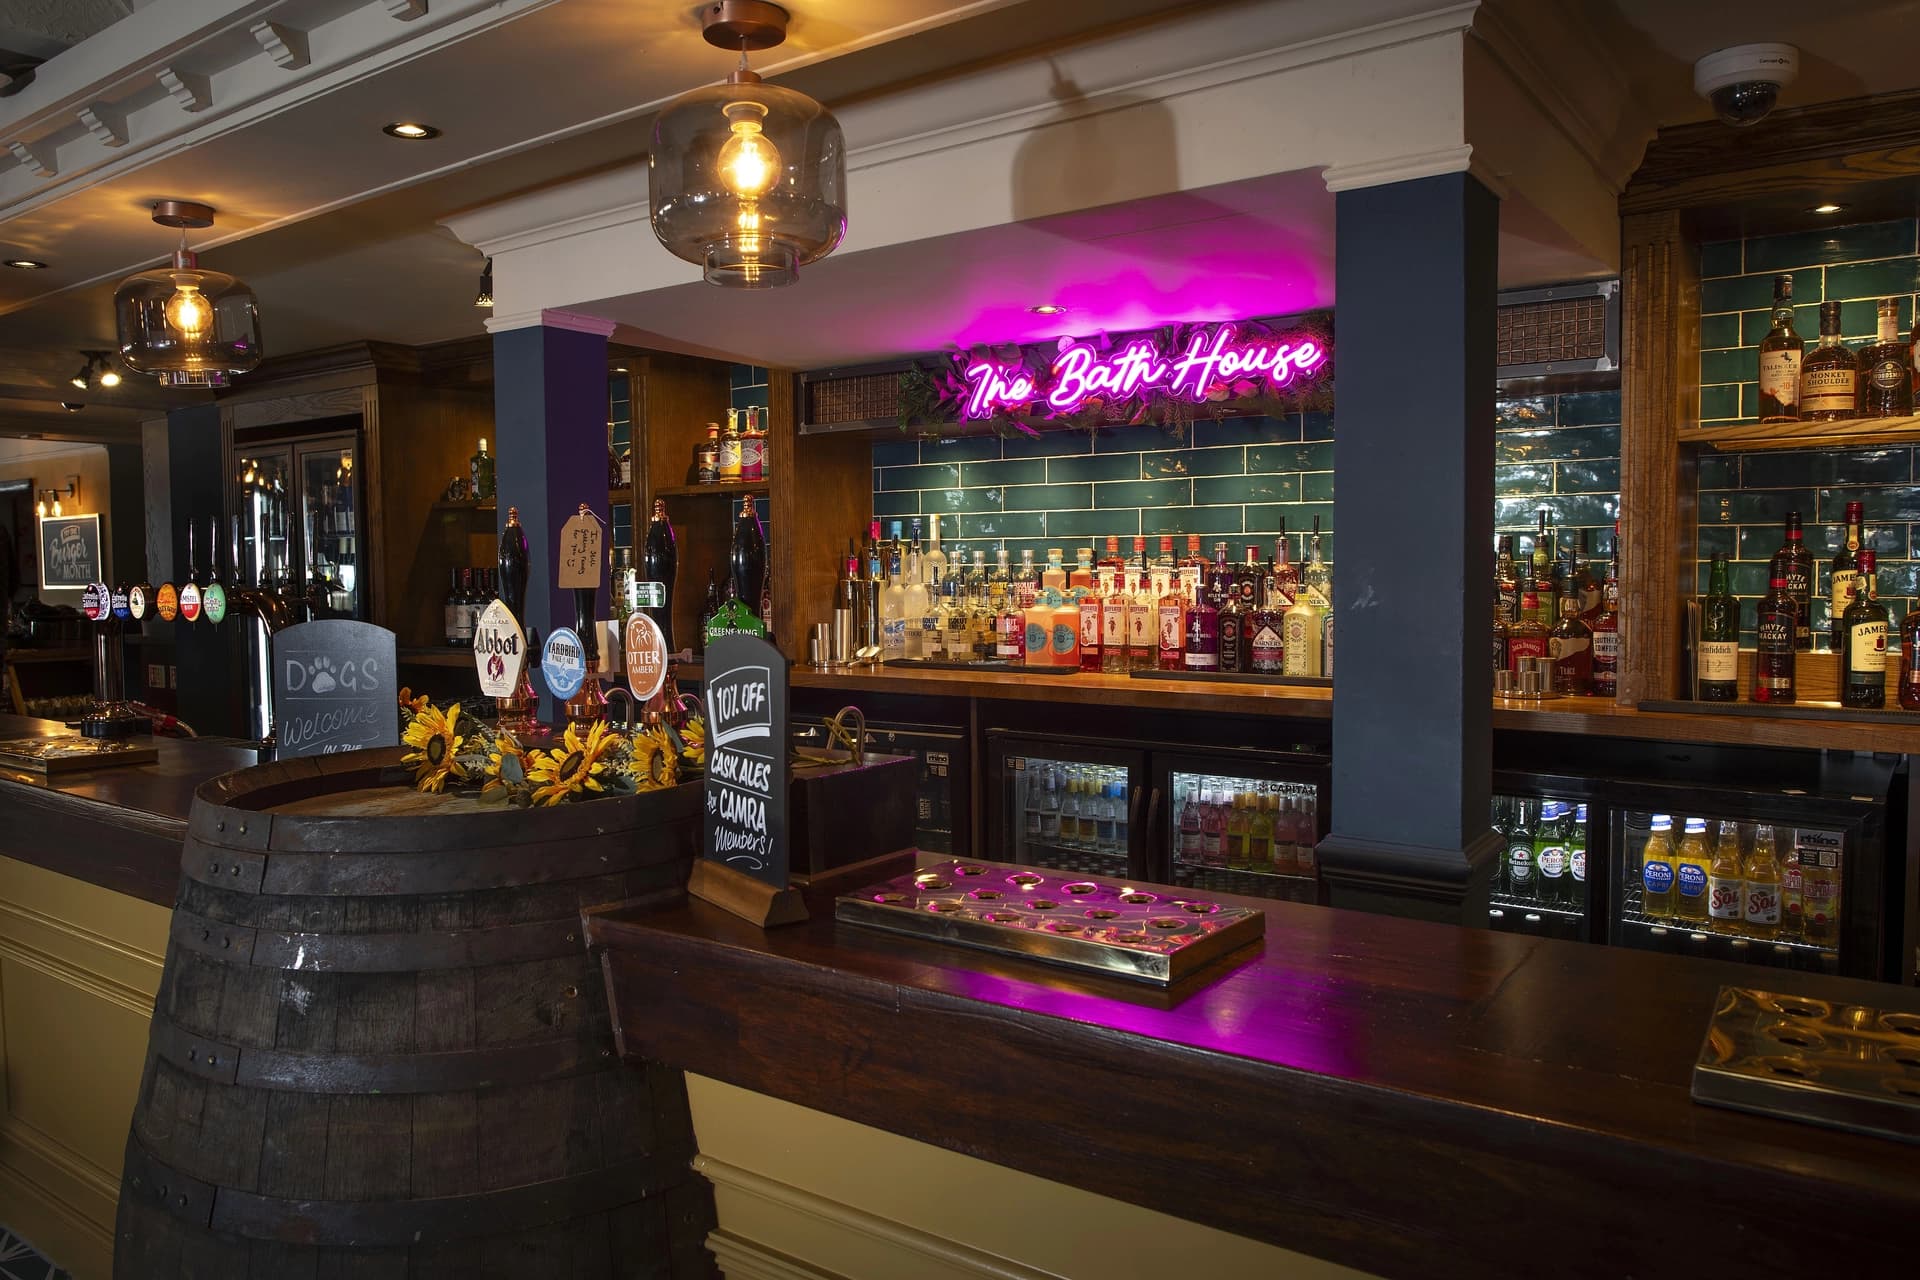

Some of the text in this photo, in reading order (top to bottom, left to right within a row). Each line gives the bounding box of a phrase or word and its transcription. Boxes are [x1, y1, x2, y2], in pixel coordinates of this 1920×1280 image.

[967, 328, 1321, 413] The Bath House
[1810, 371, 1846, 379] MONKEY
[50, 538, 88, 569] Burger
[64, 564, 91, 579] MONTH
[475, 628, 519, 655] Abbot
[548, 642, 579, 658] YARDBIRD
[628, 650, 660, 665] OTTER
[632, 665, 654, 674] AMBER
[716, 682, 766, 723] 10% OFF
[284, 702, 378, 747] Welcome
[323, 744, 338, 754] IN
[711, 750, 771, 792] CASK ALES
[1270, 783, 1314, 794] CAPITAL
[719, 787, 767, 836] CAMRA
[1800, 832, 1839, 846] rhino
[1645, 869, 1672, 880] PERONI
[1679, 872, 1704, 881] PERONI
